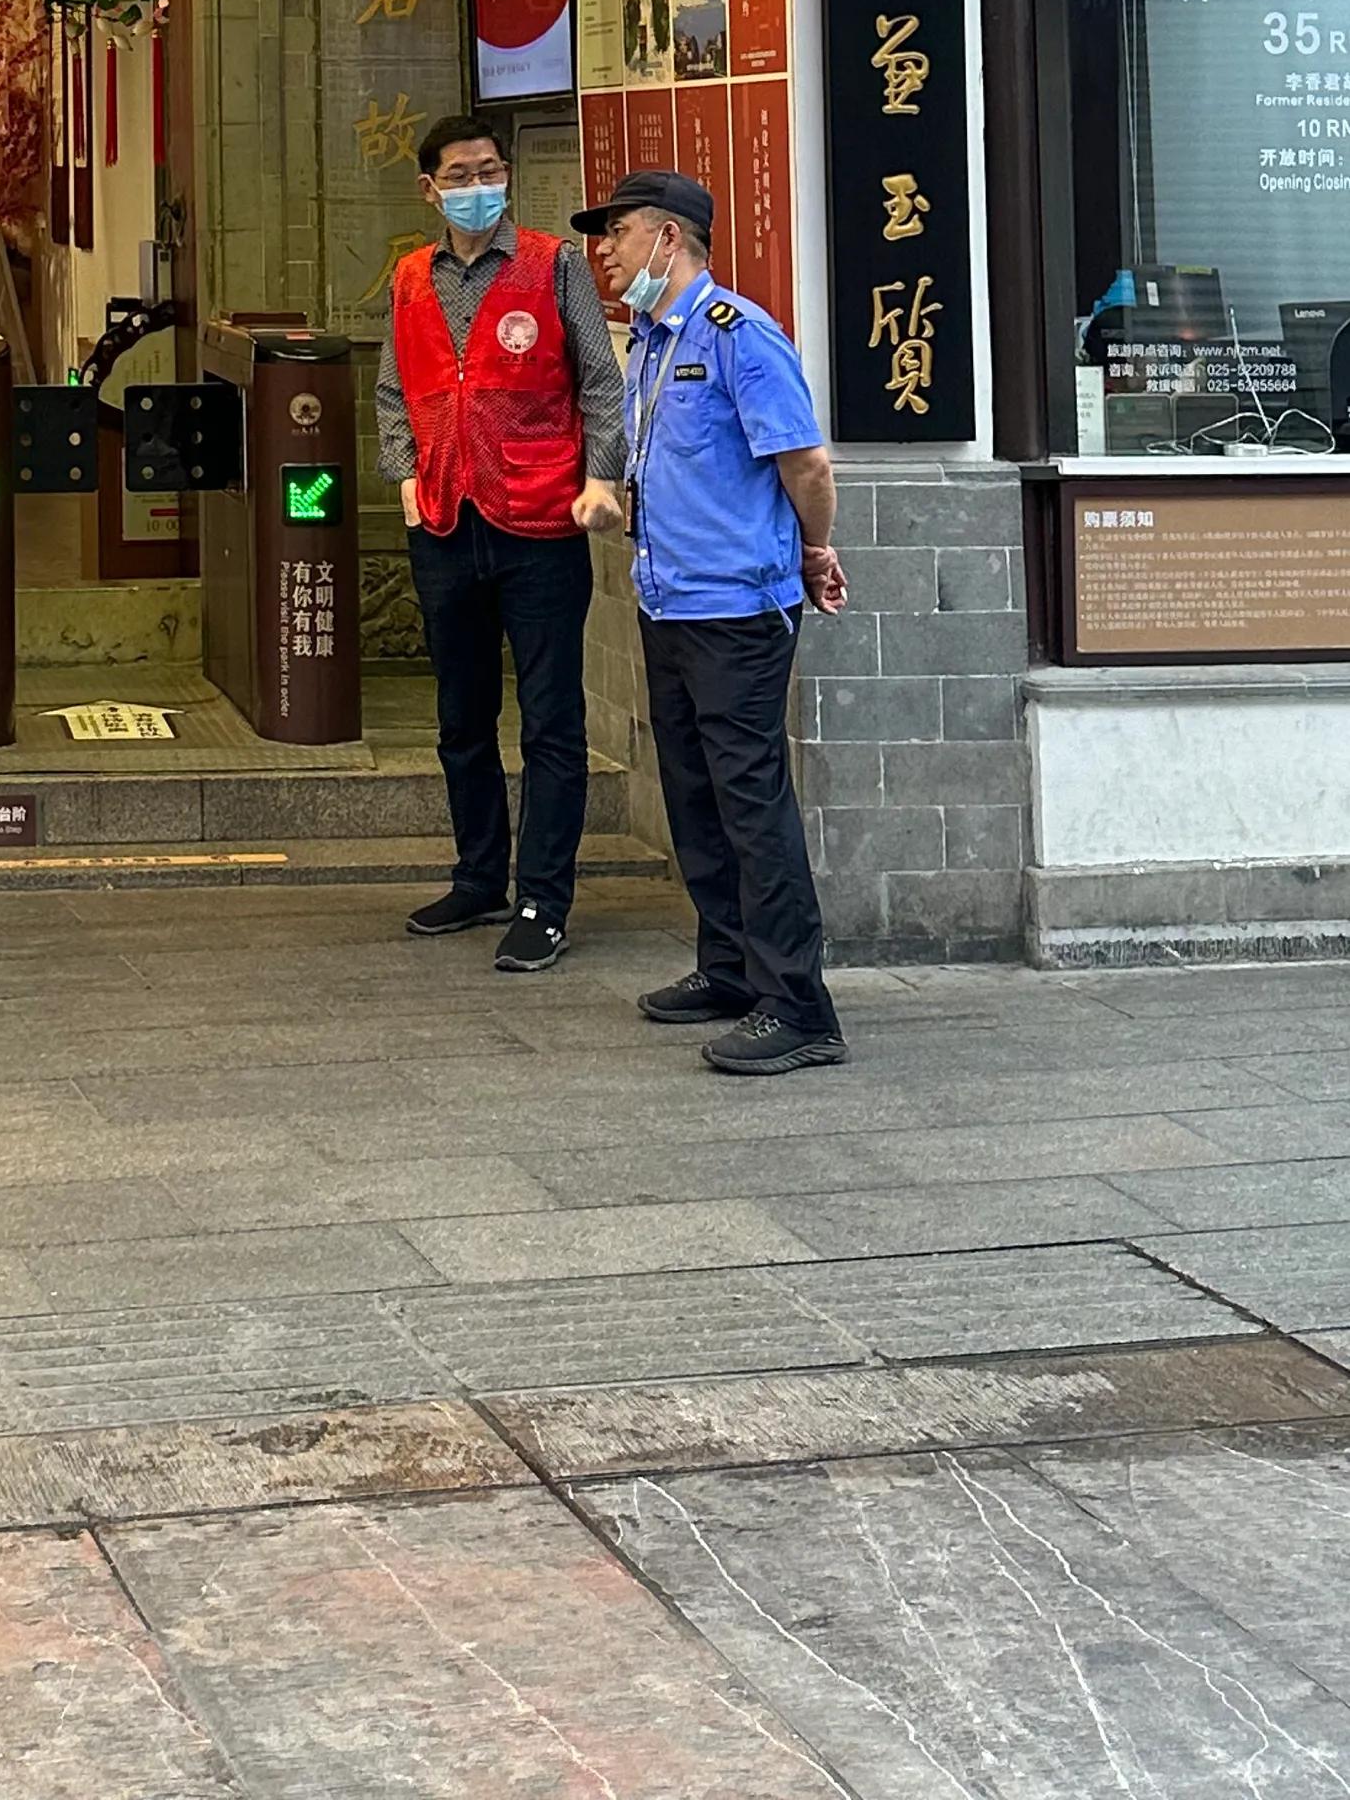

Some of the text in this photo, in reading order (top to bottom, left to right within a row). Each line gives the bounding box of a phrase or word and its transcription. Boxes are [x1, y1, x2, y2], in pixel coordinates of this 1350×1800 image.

[1263, 11, 1321, 55] 35
[1255, 93, 1303, 106] Former
[1297, 119, 1321, 138] 10
[1259, 172, 1311, 193] Opening
[1083, 510, 1154, 528] 购票须知
[292, 560, 313, 657] 有你有我
[314, 560, 335, 658] 文明健康
